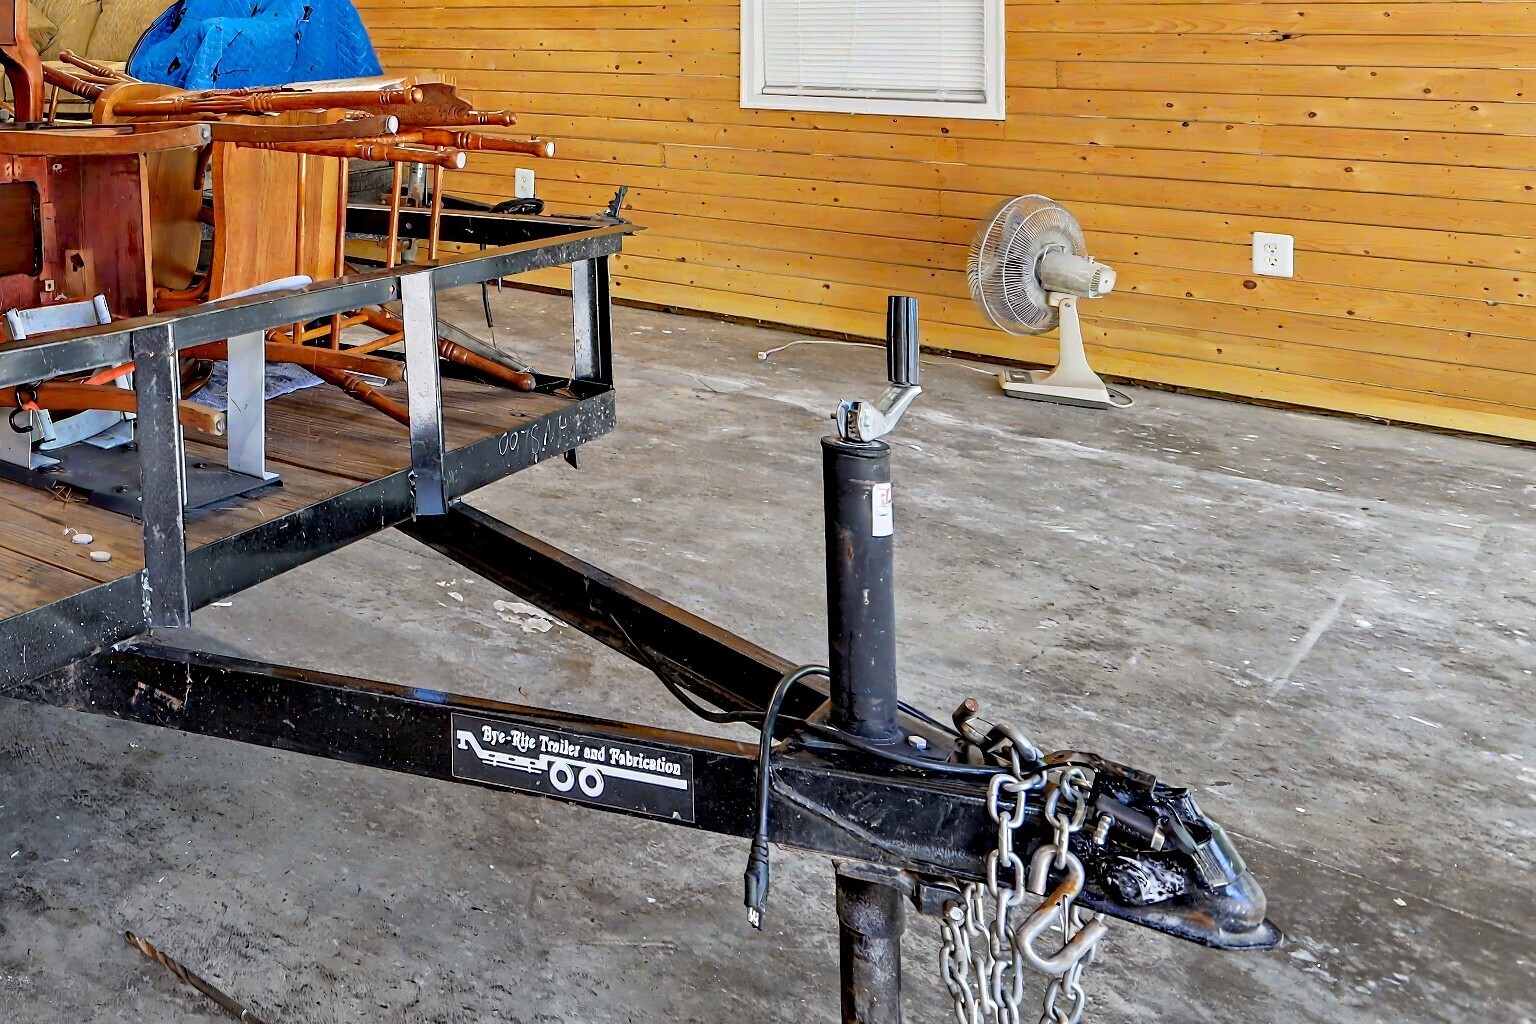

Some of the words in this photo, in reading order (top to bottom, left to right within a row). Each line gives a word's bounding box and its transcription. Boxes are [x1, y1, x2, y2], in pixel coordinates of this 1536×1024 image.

[481, 724, 536, 753] Bye-Rite
[539, 735, 581, 758] Trailer
[584, 746, 606, 762] and
[609, 747, 681, 776] Fabrication
